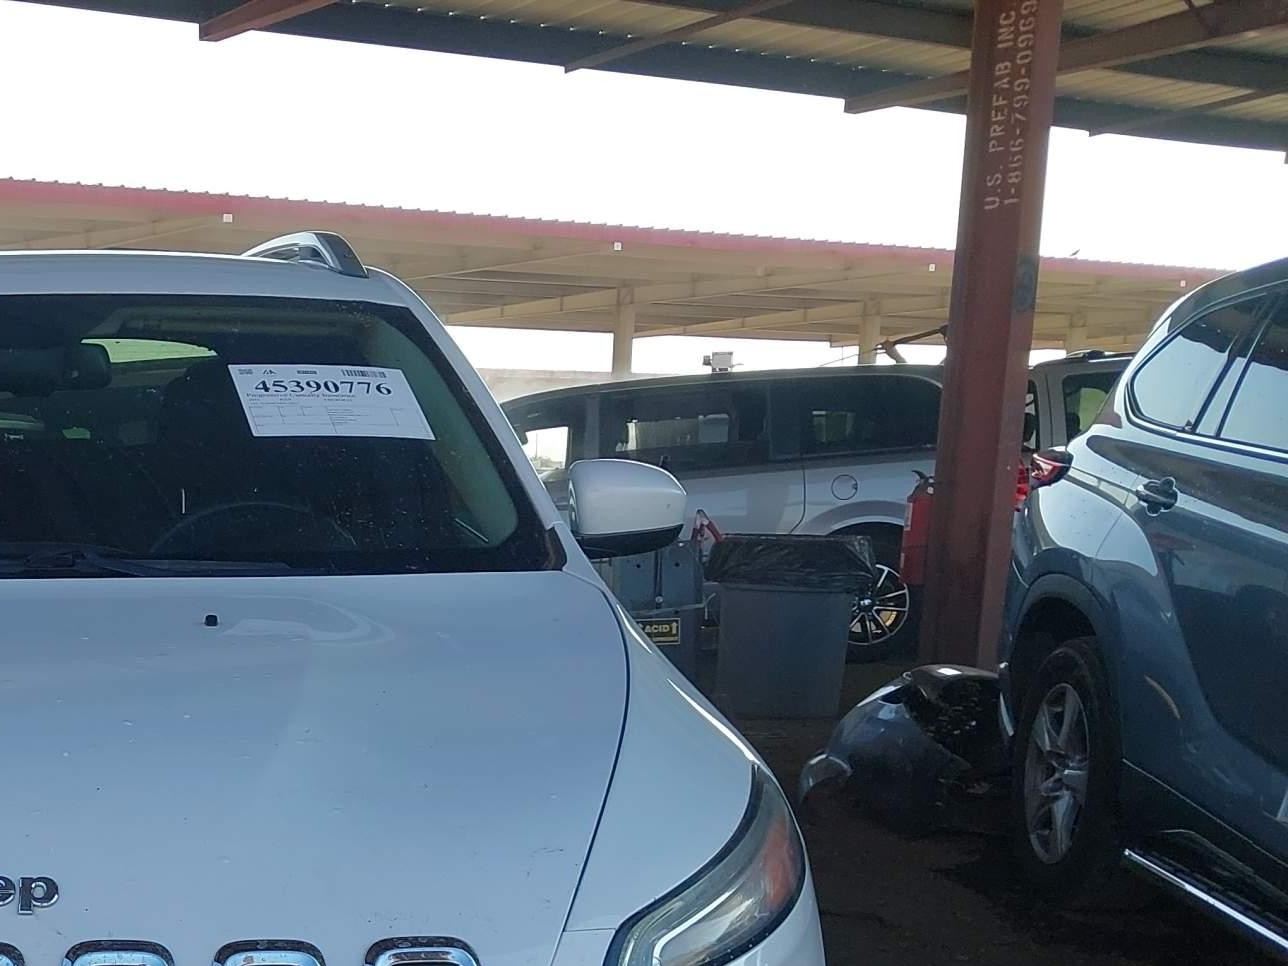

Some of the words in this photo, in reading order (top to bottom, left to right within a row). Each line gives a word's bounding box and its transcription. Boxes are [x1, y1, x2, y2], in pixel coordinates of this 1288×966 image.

[989, 61, 1011, 152] PREFAB
[984, 165, 1002, 210] U.S.
[255, 380, 392, 395] 45390776
